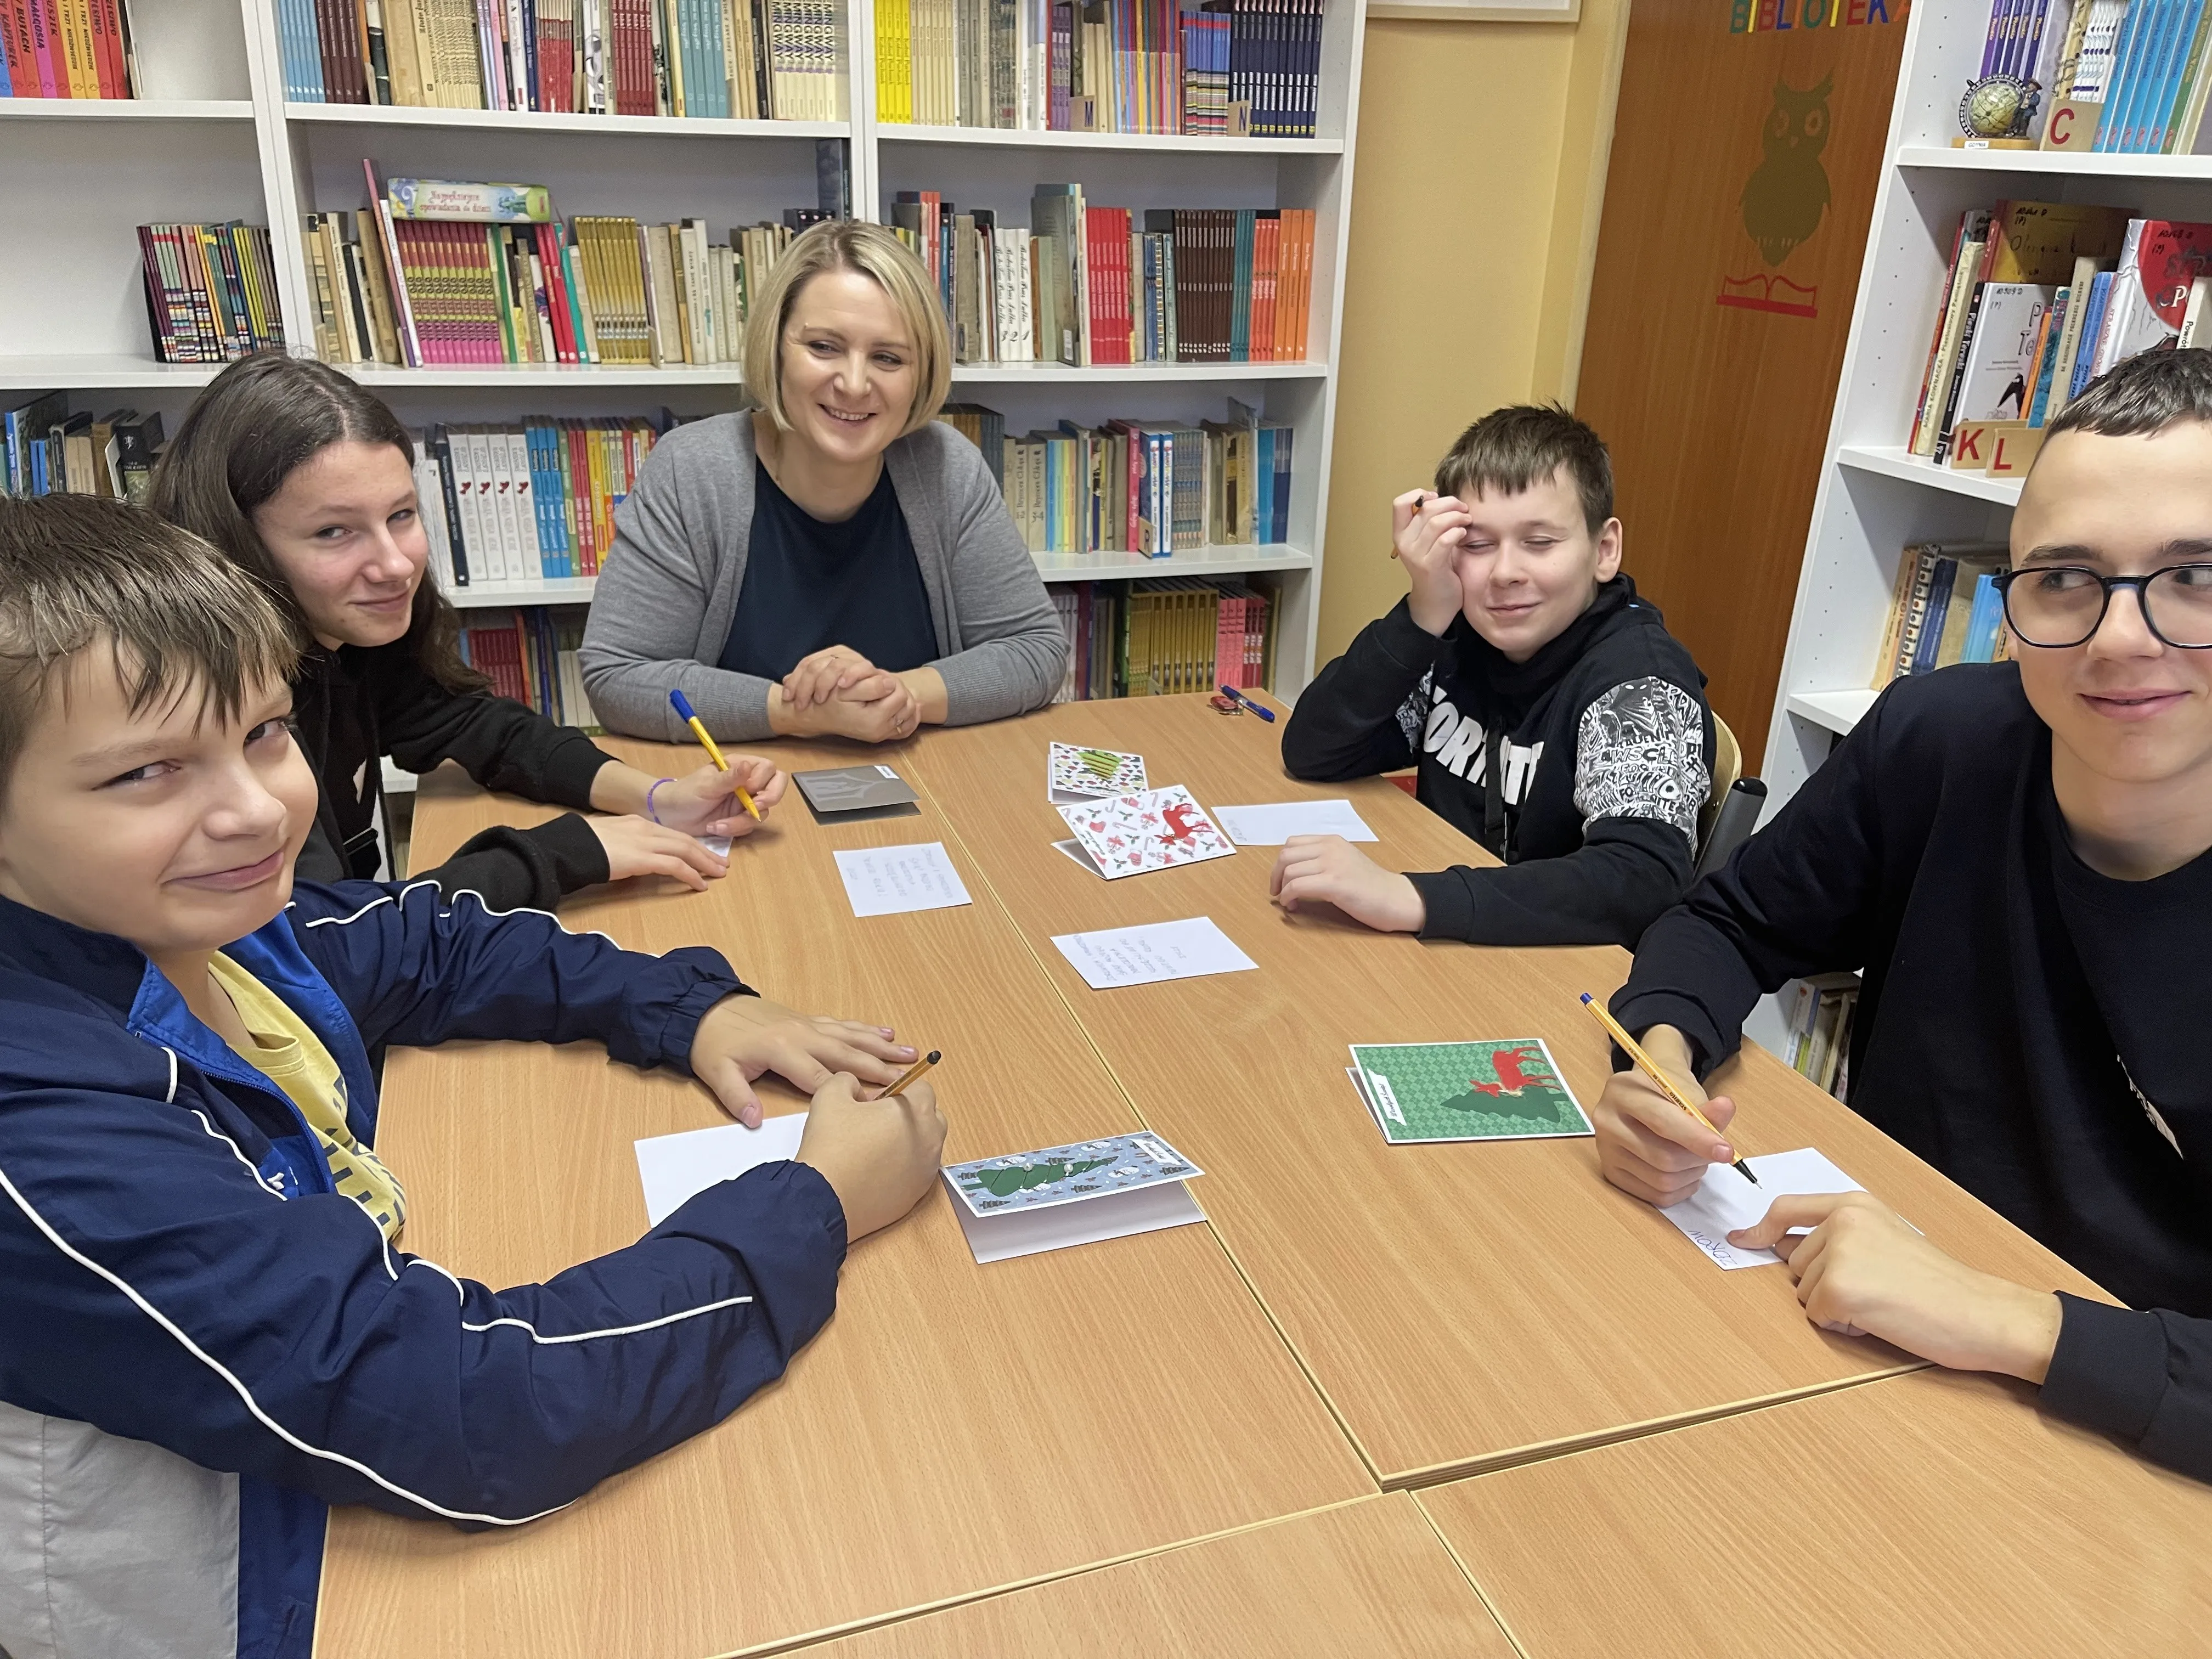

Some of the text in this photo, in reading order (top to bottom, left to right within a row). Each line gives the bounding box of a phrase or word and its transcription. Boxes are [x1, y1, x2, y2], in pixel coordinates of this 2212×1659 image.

[16, 7, 31, 54] BUTACH
[2050, 108, 2074, 145] C
[1956, 428, 1984, 461] K
[1993, 437, 2012, 471] L
